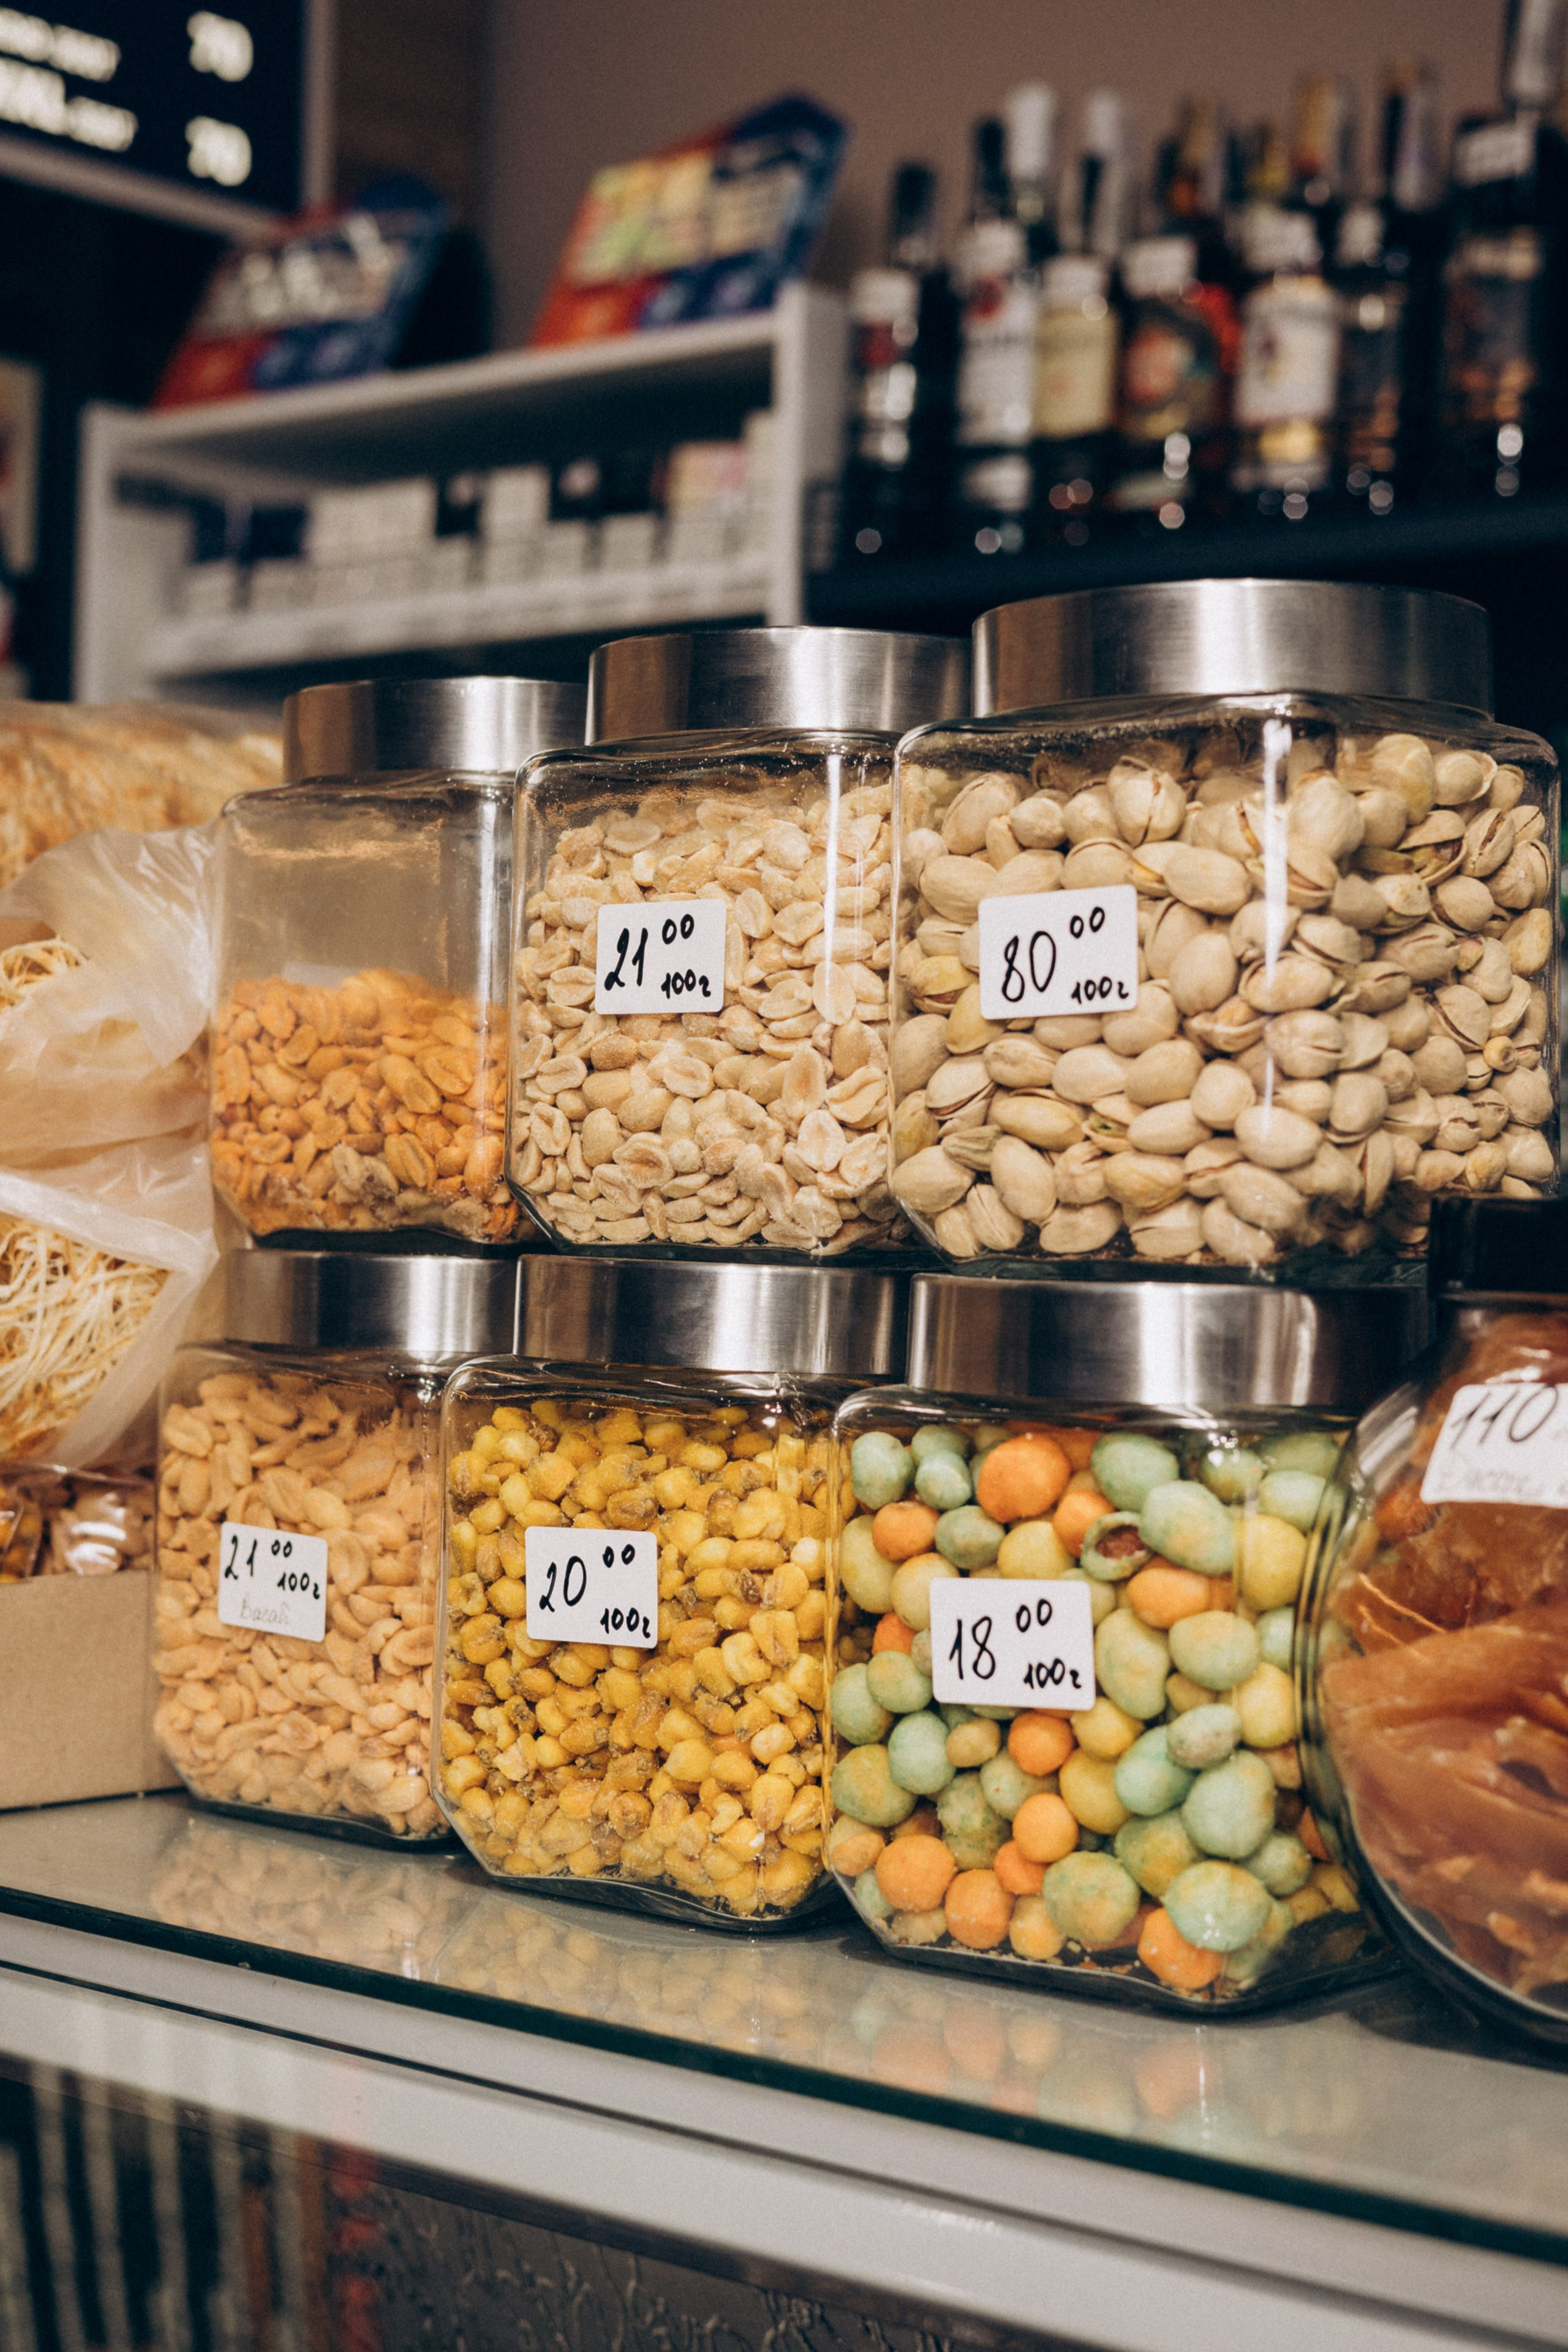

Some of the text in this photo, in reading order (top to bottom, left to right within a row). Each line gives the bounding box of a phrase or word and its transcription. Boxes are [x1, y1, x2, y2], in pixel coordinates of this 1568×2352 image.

[604, 913, 695, 991] 21 00
[1001, 906, 1106, 1003] 80 00
[1450, 1385, 1559, 1449] 110
[224, 1535, 293, 1580] 21 00
[538, 1544, 636, 1613] 20 00
[949, 1598, 1053, 1680] 18 00
